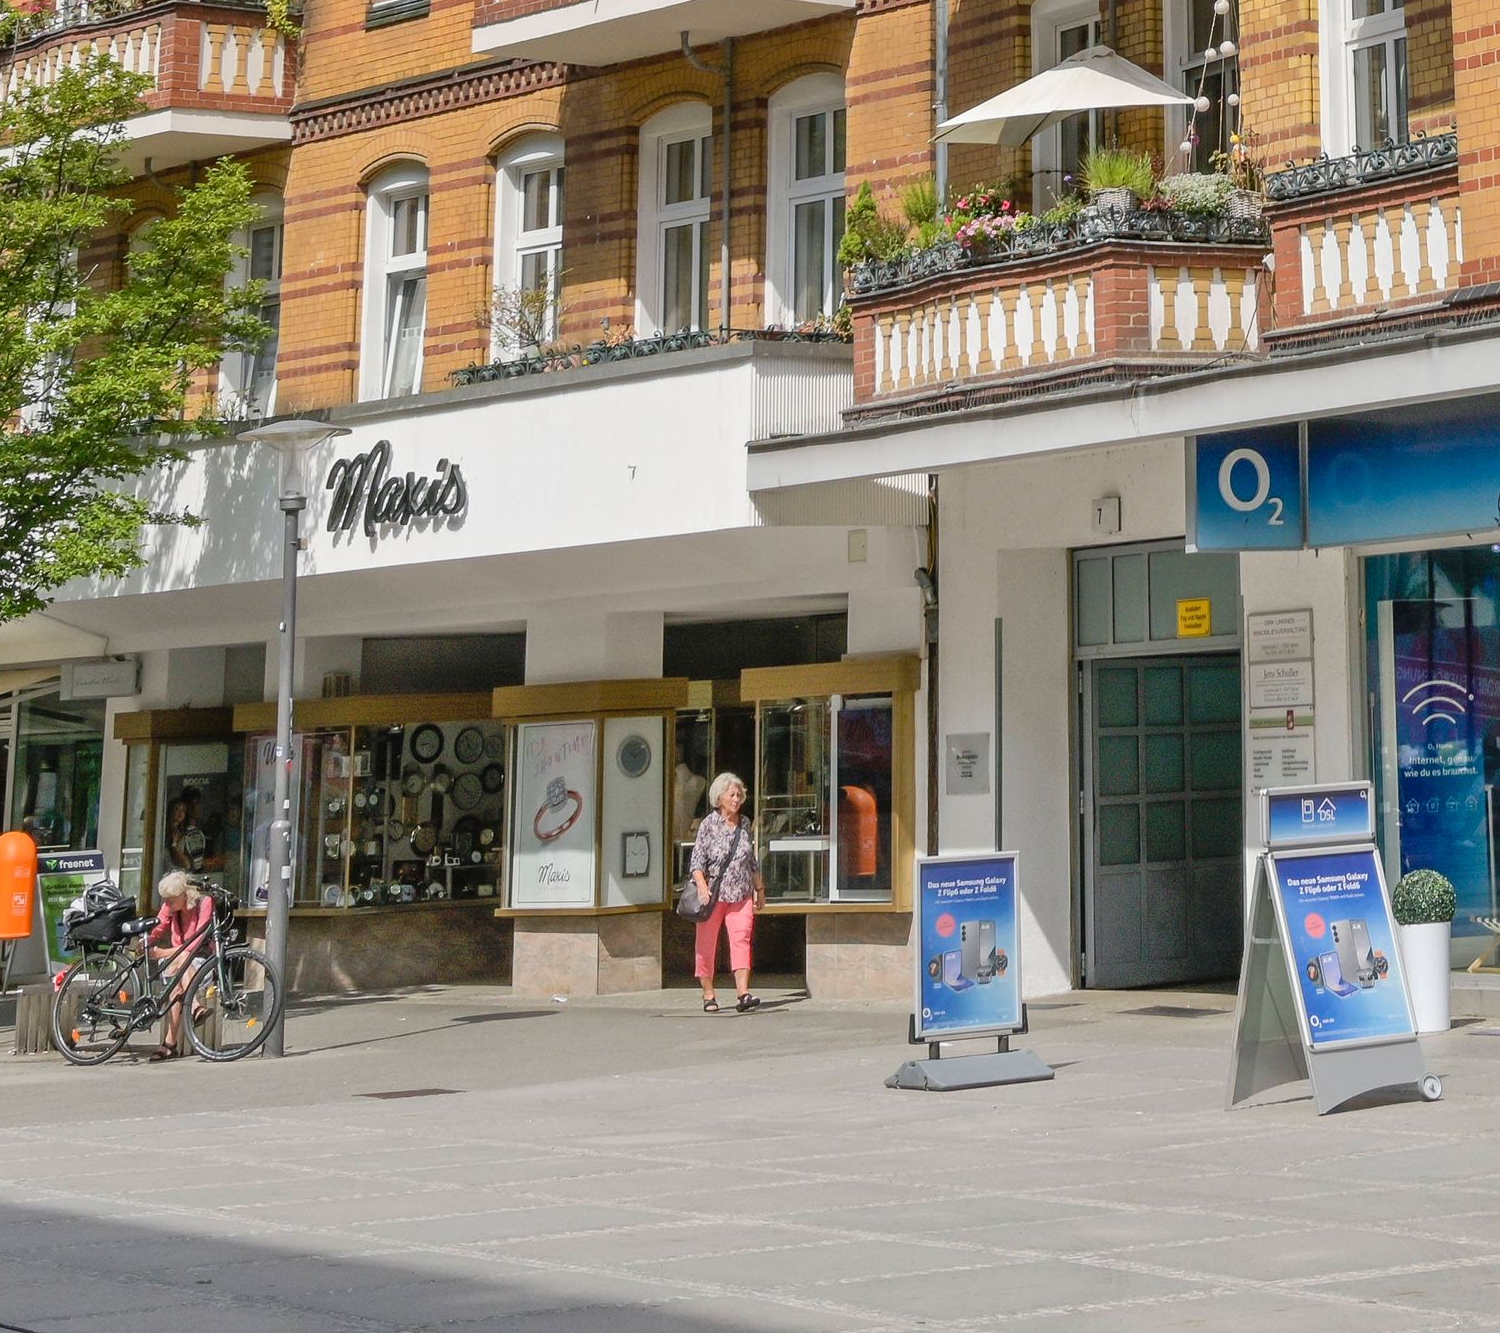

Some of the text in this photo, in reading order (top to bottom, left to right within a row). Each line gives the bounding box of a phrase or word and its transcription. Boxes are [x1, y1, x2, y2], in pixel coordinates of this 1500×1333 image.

[1409, 755, 1446, 765] Internet,
[1404, 768, 1418, 778] wie
[1420, 768, 1431, 777] du
[1443, 766, 1478, 776] brauchst.
[1319, 809, 1336, 821] DSL
[59, 859, 94, 869] freenet
[538, 863, 570, 884] Maxis
[1287, 878, 1300, 886] Das
[1317, 875, 1345, 884] Samsung
[1346, 873, 1368, 881] Galaxy
[957, 879, 984, 887] Samsung
[1305, 886, 1321, 894] Flip6
[1322, 884, 1336, 892] oder
[1343, 882, 1360, 890] Fold6
[943, 889, 959, 897] Flip6
[980, 885, 997, 893] Fold6
